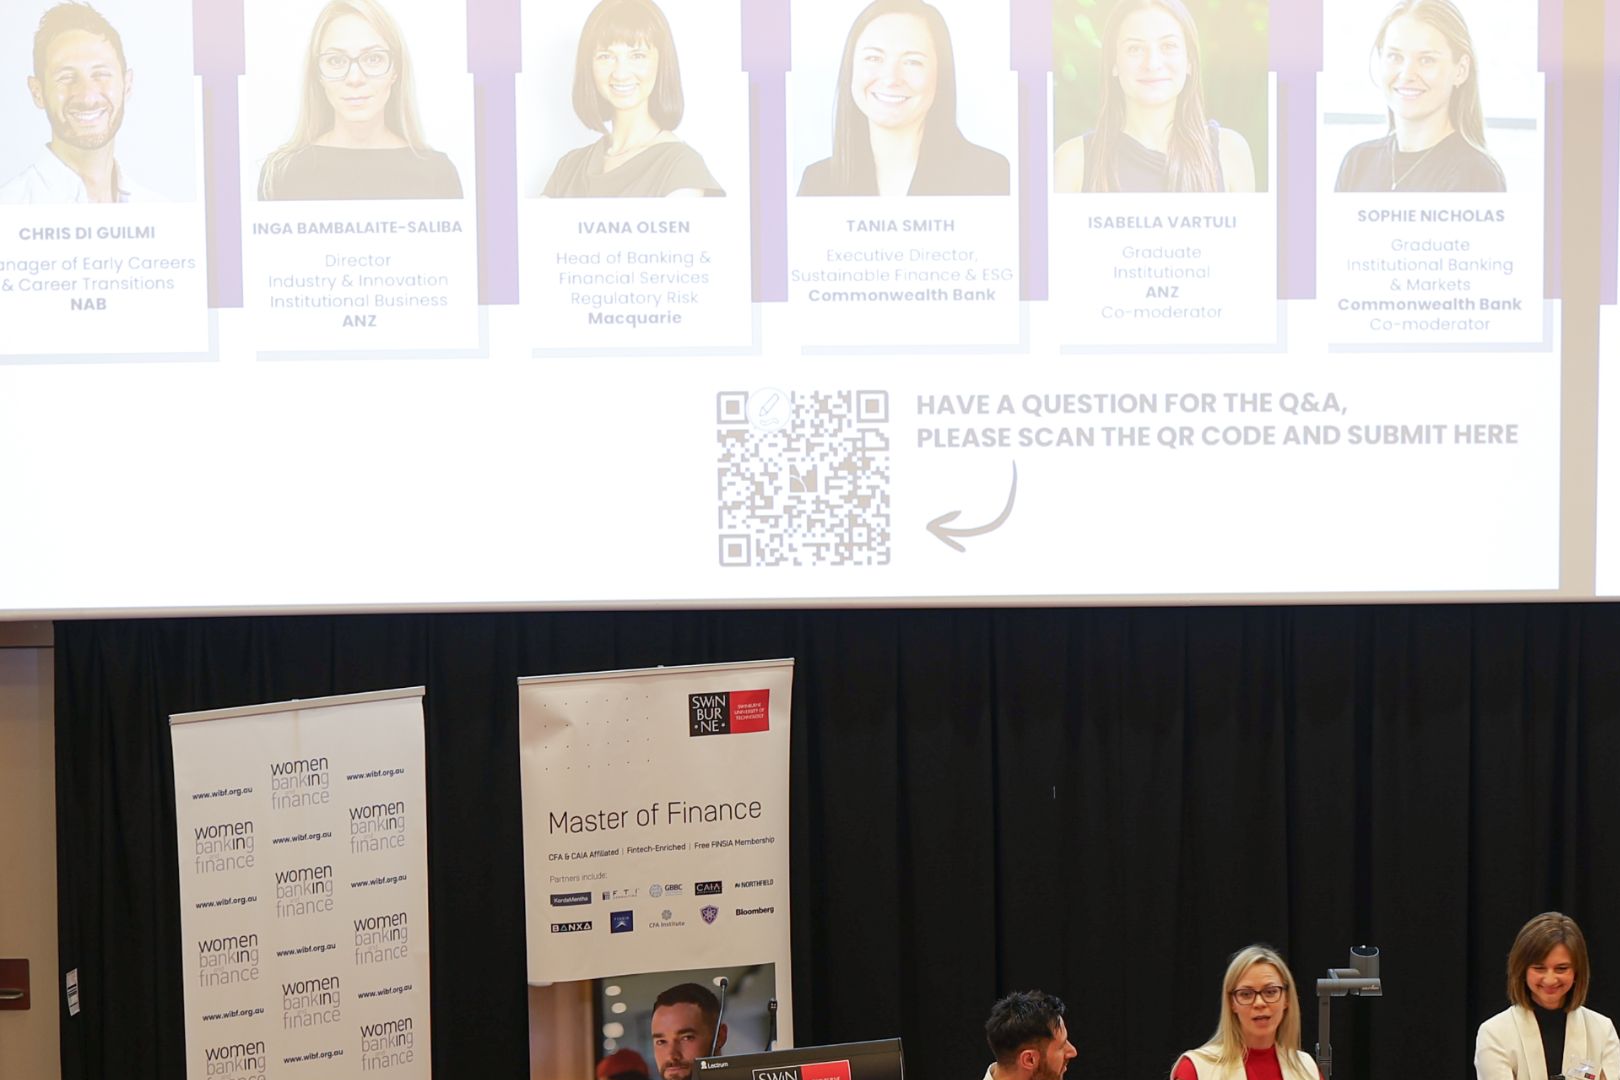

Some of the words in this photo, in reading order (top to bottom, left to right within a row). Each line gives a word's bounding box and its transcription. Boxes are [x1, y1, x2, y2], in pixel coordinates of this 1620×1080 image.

[1088, 215, 1163, 228] ISABELLA
[1167, 215, 1236, 228] VARTULI
[1357, 209, 1416, 222] SOPHIE
[1420, 209, 1504, 222] NICHOLAS
[18, 226, 71, 240] CHRIS
[75, 226, 92, 239] DI
[96, 225, 155, 239] GUILMI
[252, 222, 293, 234] INGA
[297, 220, 462, 234] BAMBALAITE-SALIBA
[578, 221, 632, 234] IVANA
[636, 220, 689, 233] OLSEN
[846, 219, 897, 232] TANIA
[902, 219, 954, 231] SMITH
[0, 260, 56, 275] nager
[61, 256, 77, 270] of
[82, 256, 123, 273] Early
[127, 256, 195, 269] Careers
[325, 254, 391, 267] Director
[1, 278, 13, 291] &
[18, 278, 77, 291] Career
[82, 276, 174, 290] Transitions
[268, 274, 336, 291] Industry
[341, 274, 353, 287] &
[359, 273, 448, 287] Innovation
[808, 288, 948, 301] Commonwealth
[952, 288, 995, 301] Bank
[1145, 285, 1179, 298] ANZ
[70, 297, 106, 310] NAB
[270, 293, 368, 308] Institutional
[374, 294, 447, 306] Business
[1337, 297, 1475, 310] Commonwealth
[1479, 297, 1521, 310] Bank
[342, 314, 376, 327] ANZ
[588, 310, 682, 328] Macquarie
[917, 394, 989, 415] HAVE
[996, 394, 1015, 414] A
[1022, 393, 1157, 417] QUESTION
[1165, 392, 1216, 413] FOR
[1223, 392, 1272, 412] THE
[1278, 392, 1347, 415] Q&A,
[917, 427, 1011, 448] PLEASE
[1018, 426, 1094, 447] SCAN
[1100, 426, 1150, 446] THE
[1156, 426, 1194, 449] QR
[1201, 425, 1275, 445] CODE
[1282, 424, 1341, 445] AND
[1347, 424, 1447, 444] SUBMIT
[1454, 423, 1518, 444] HERE
[697, 708, 722, 720] BUR
[271, 757, 329, 775] women
[272, 772, 329, 790] banking
[347, 767, 404, 781] www.wibf.org.au
[273, 789, 330, 810] finance
[350, 801, 405, 821] women
[549, 810, 628, 834] Master
[636, 805, 659, 826] of
[668, 801, 761, 824] Finance
[195, 820, 253, 840] women
[350, 814, 405, 835] banking
[273, 831, 331, 845] www.wibf.org.au
[351, 832, 405, 854] finance
[734, 836, 775, 846] Membership
[195, 835, 254, 856] banking
[626, 844, 686, 854] Fintech-Enriched
[195, 853, 255, 874] finance
[549, 874, 580, 883] Partners
[735, 906, 775, 916] Bloomberg
